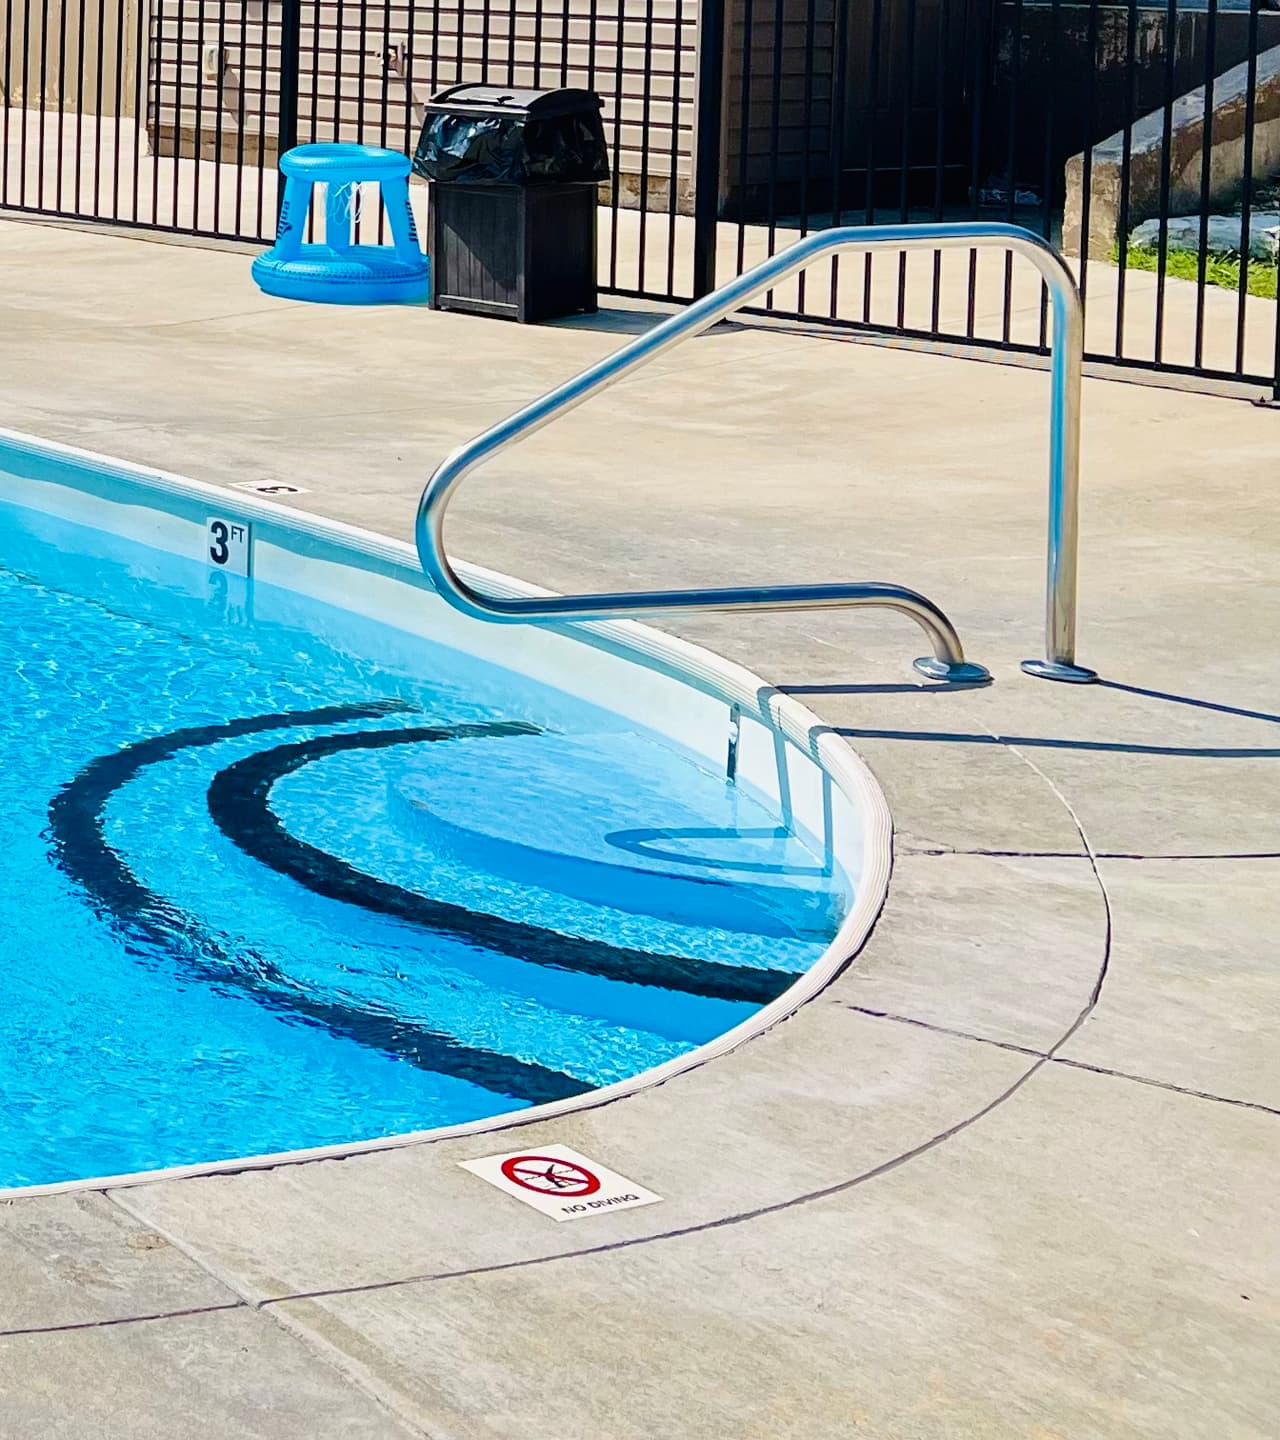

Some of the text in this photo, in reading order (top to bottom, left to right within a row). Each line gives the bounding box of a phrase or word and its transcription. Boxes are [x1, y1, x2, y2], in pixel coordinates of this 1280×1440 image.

[210, 521, 245, 565] 3 FT
[561, 1194, 640, 1214] NO DIVING
